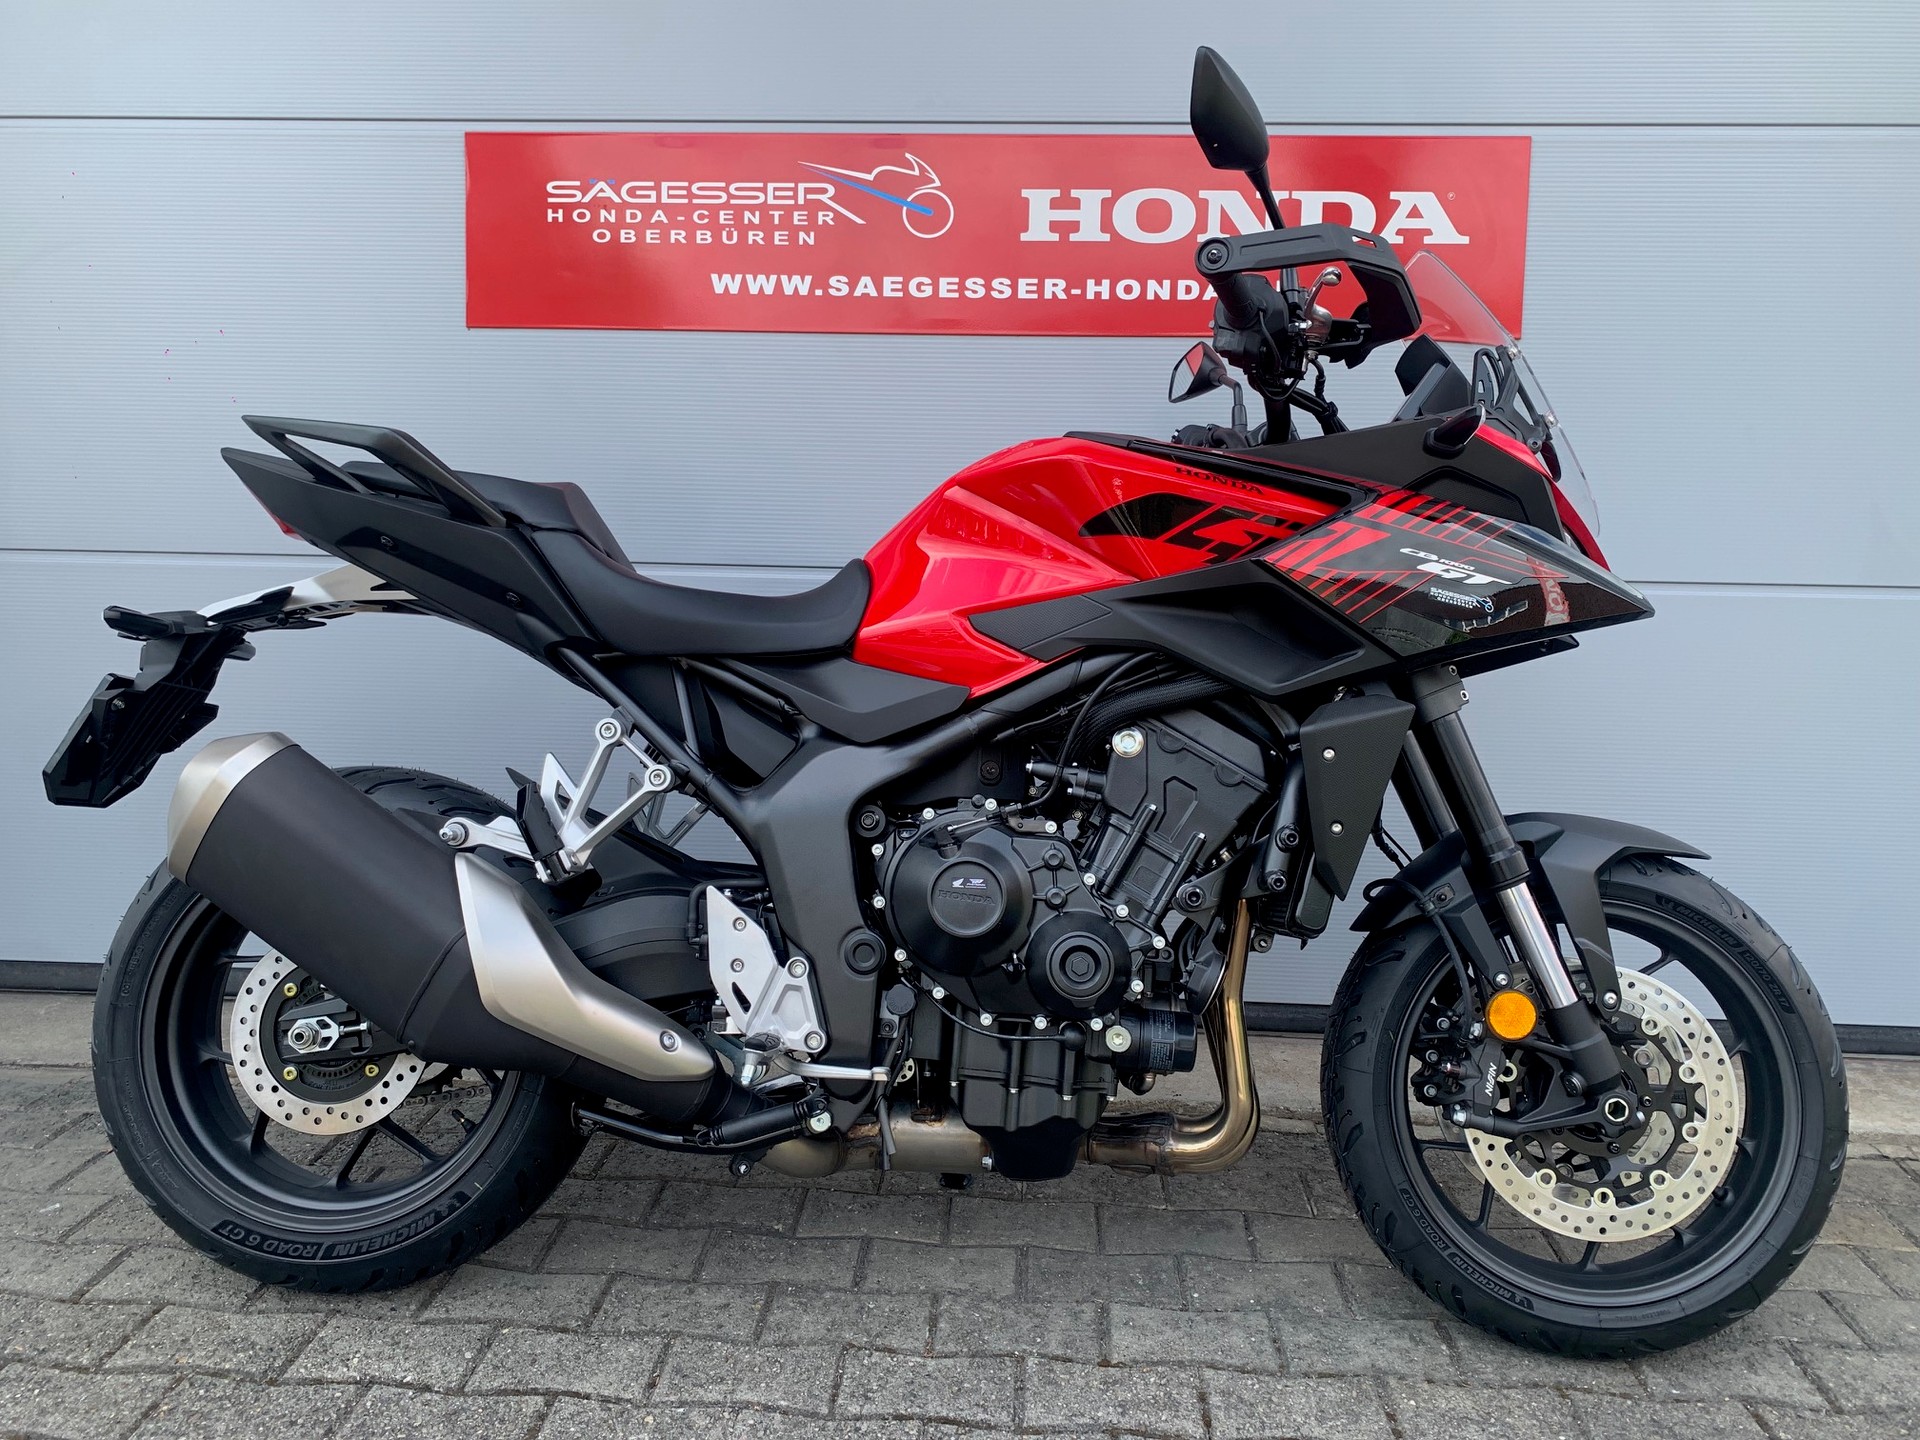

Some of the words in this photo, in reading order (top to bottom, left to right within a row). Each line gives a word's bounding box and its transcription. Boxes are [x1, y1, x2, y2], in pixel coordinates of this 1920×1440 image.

[546, 178, 864, 222] SÄGESSER
[547, 208, 835, 225] HONDA-CENTER
[1020, 187, 1470, 244] HONDA
[592, 227, 816, 246] OBERBÜREN
[1174, 466, 1265, 495] HONDA
[937, 889, 996, 905] HONDA
[1679, 904, 1739, 948] MICHELIN
[1402, 1192, 1415, 1207] GT
[220, 1224, 245, 1241] GT
[246, 1235, 260, 1247] 6
[332, 1213, 435, 1257] MICHELIN
[1419, 1218, 1446, 1250] ROAD
[263, 1240, 319, 1258] ROAD
[1453, 1256, 1512, 1300] MICHELIN
